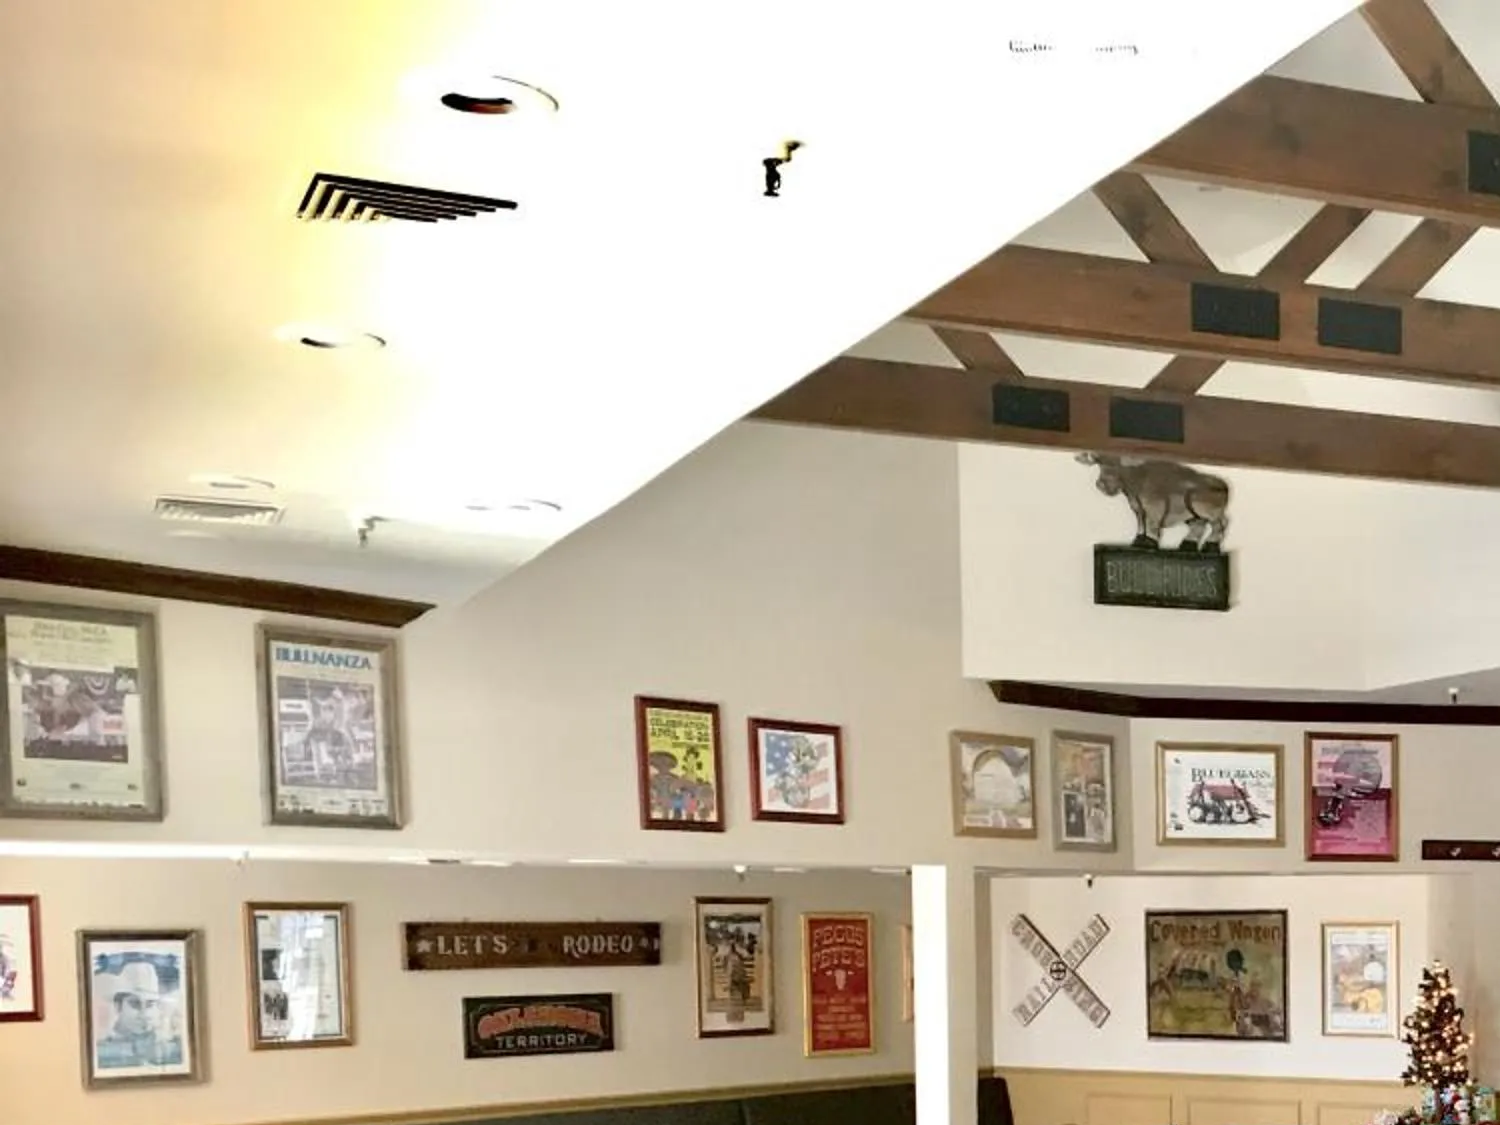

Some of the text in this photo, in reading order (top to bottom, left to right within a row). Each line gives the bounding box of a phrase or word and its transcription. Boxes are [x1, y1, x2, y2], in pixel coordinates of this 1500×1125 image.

[1147, 919, 1281, 943] Covered Wagon
[562, 934, 634, 958] RODEO
[495, 1032, 590, 1050] TERRITORY
